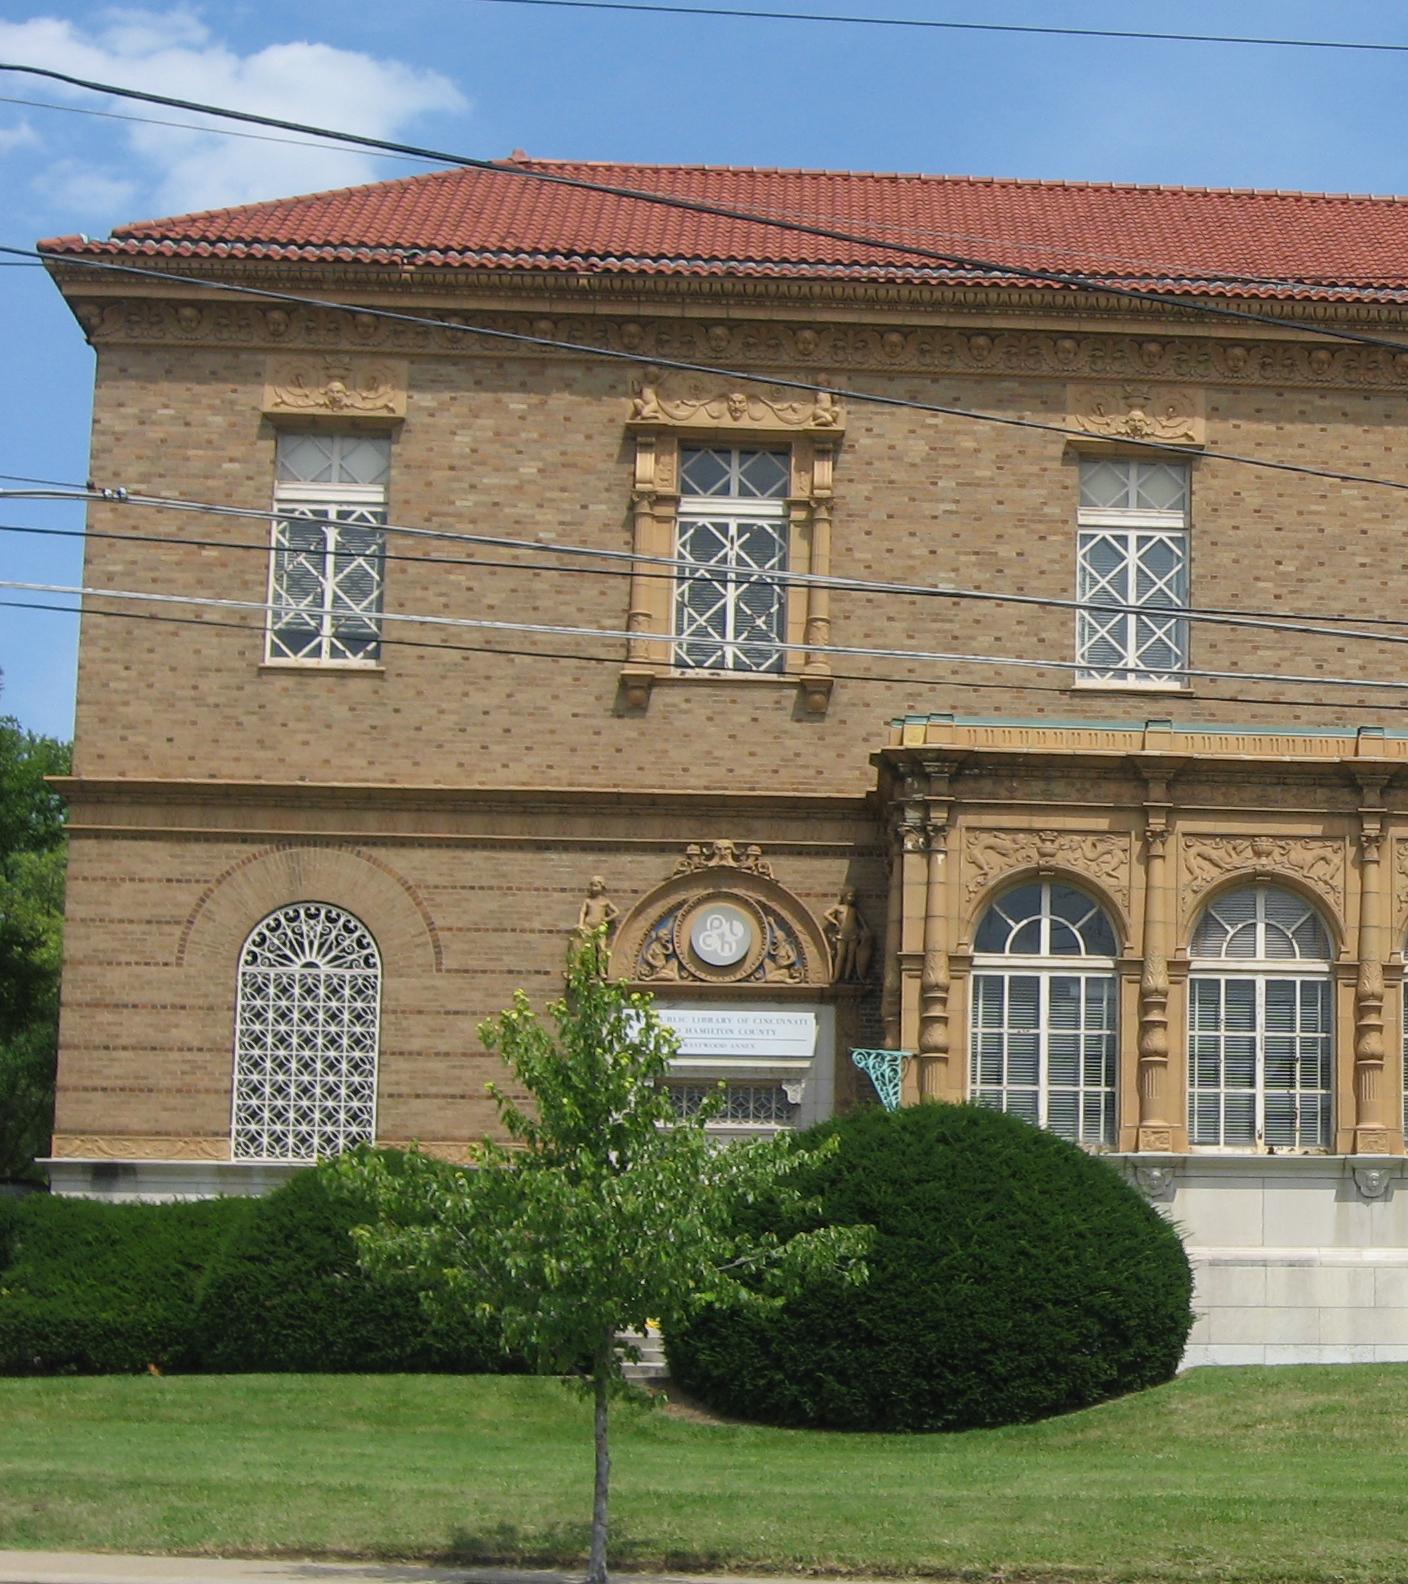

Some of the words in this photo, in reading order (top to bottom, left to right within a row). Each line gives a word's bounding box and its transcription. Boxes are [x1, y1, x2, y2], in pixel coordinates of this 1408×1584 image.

[692, 1016, 732, 1024] LIBRARY
[752, 1017, 809, 1026] CINCINNATI
[685, 1027, 734, 1036] HAMILTON
[737, 1028, 777, 1037] COUNTY
